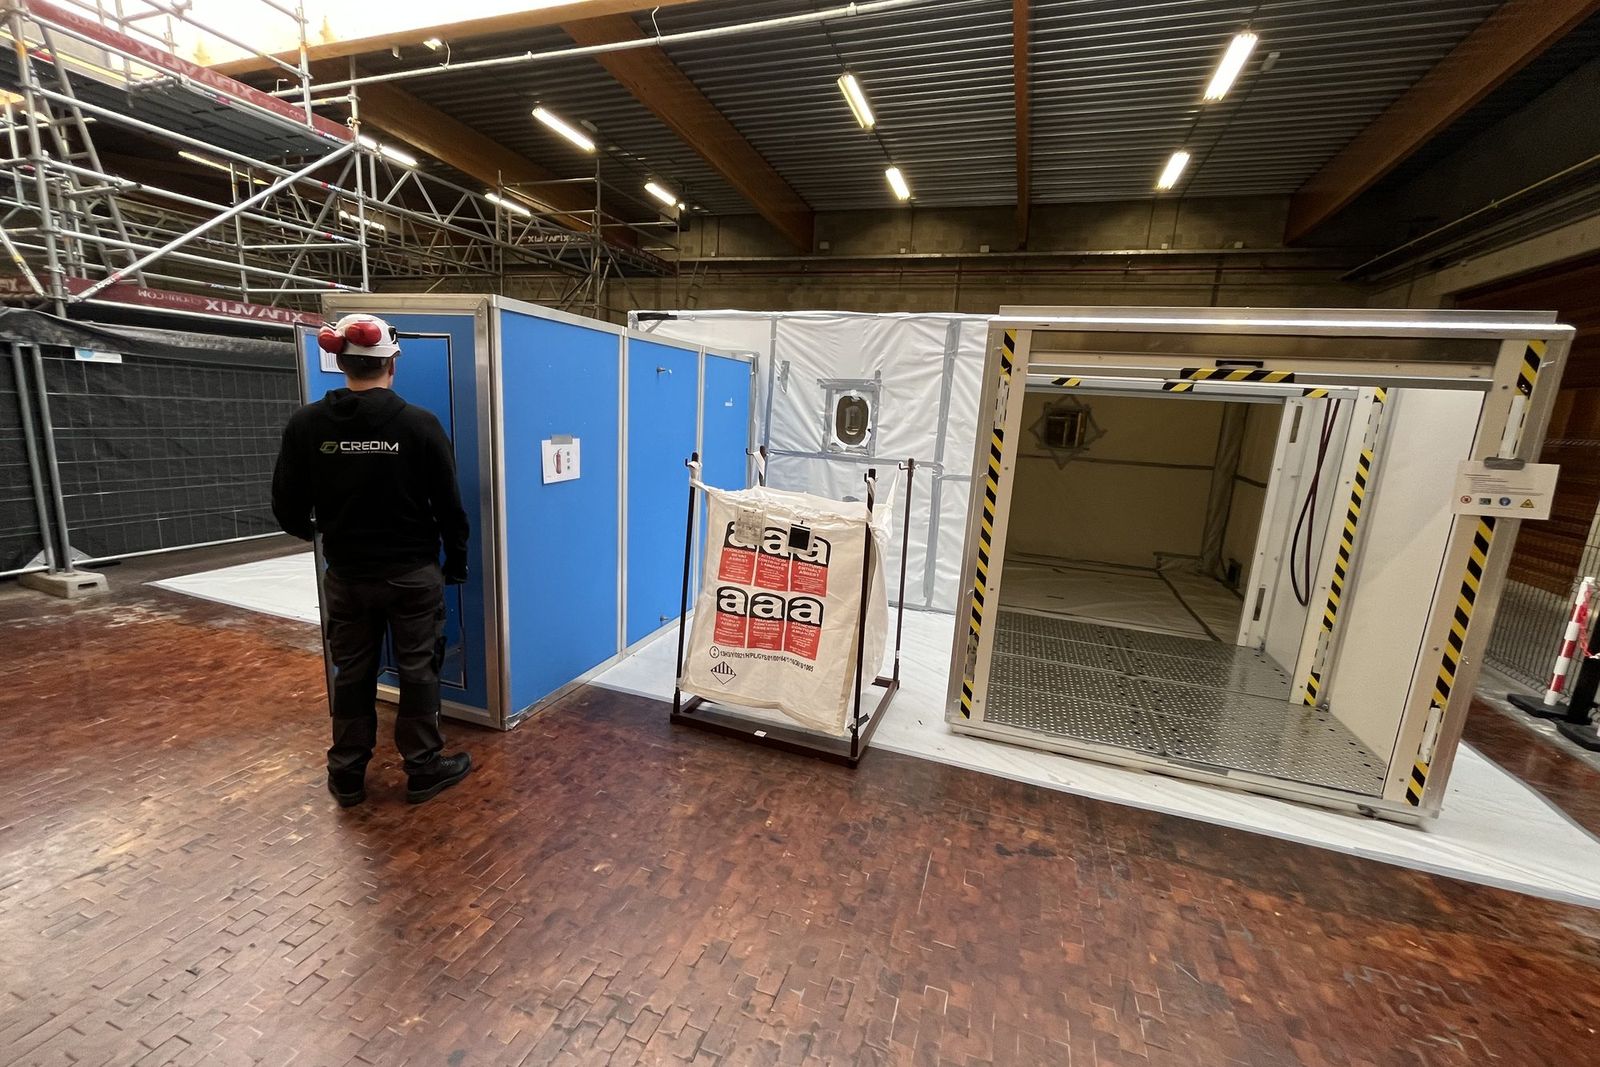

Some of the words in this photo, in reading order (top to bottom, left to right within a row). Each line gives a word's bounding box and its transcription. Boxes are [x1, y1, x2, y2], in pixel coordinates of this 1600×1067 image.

[340, 440, 399, 451] CREDIM
[719, 588, 746, 615] a
[753, 595, 783, 619] a
[789, 599, 820, 625] a
